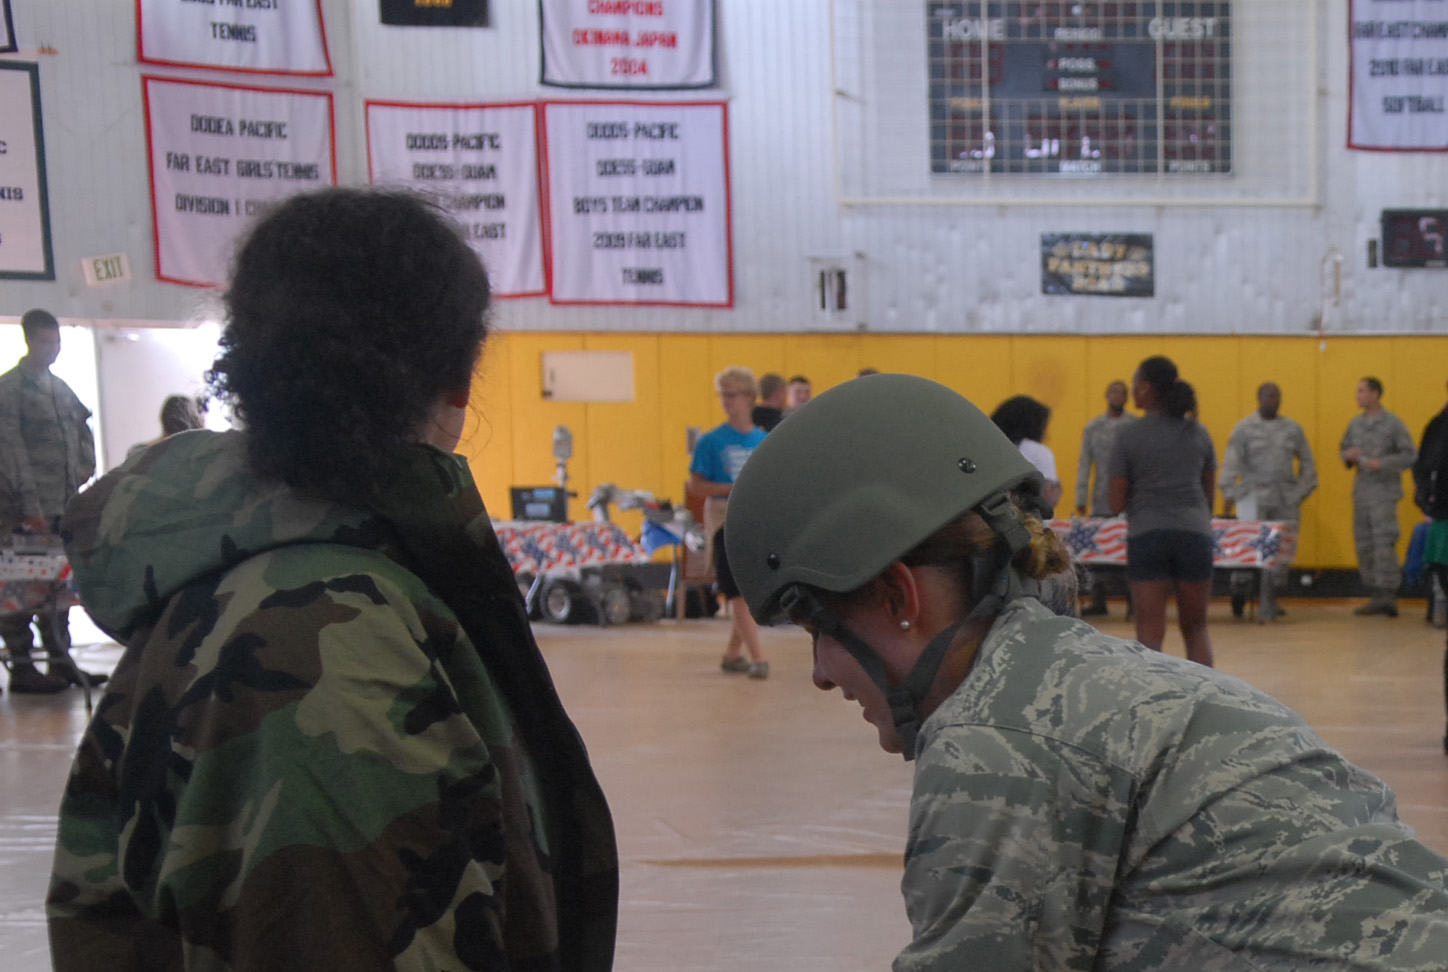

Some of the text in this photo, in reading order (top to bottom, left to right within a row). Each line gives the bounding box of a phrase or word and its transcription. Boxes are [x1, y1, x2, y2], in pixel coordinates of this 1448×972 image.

[210, 21, 257, 42] TENNIS
[942, 17, 1217, 41] HOME GUEST
[239, 119, 288, 139] PACIFIC
[166, 151, 190, 171] FAR
[196, 155, 230, 176] EAST
[175, 193, 230, 216] DIVISION
[654, 232, 686, 249] EAST
[93, 256, 124, 280] EXIT
